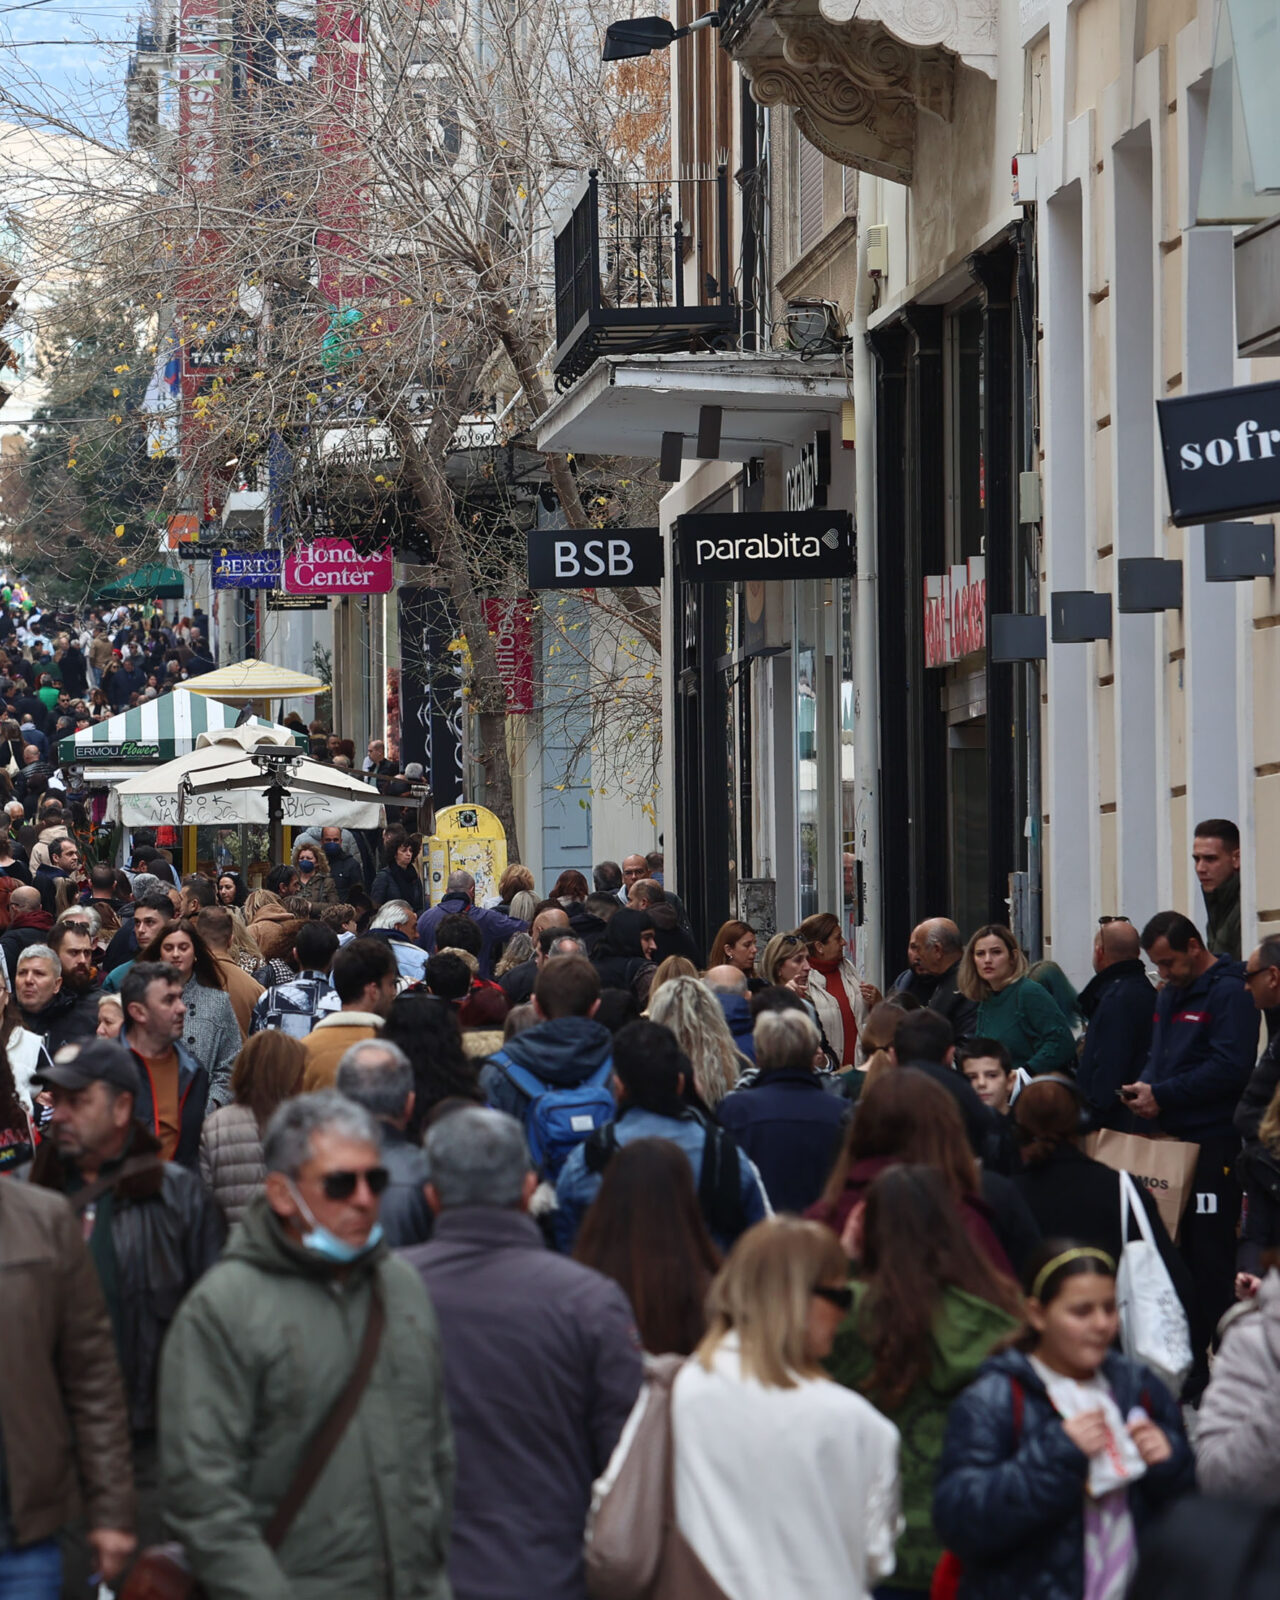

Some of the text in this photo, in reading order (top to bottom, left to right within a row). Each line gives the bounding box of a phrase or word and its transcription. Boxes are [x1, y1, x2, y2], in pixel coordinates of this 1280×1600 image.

[1180, 419, 1280, 472] sofr
[293, 541, 385, 564] Hondos
[553, 539, 635, 578] BSB
[695, 531, 821, 566] parabita
[294, 564, 374, 587] Center
[76, 742, 158, 756] ERMOU Flower
[1139, 1175, 1169, 1190] MOS
